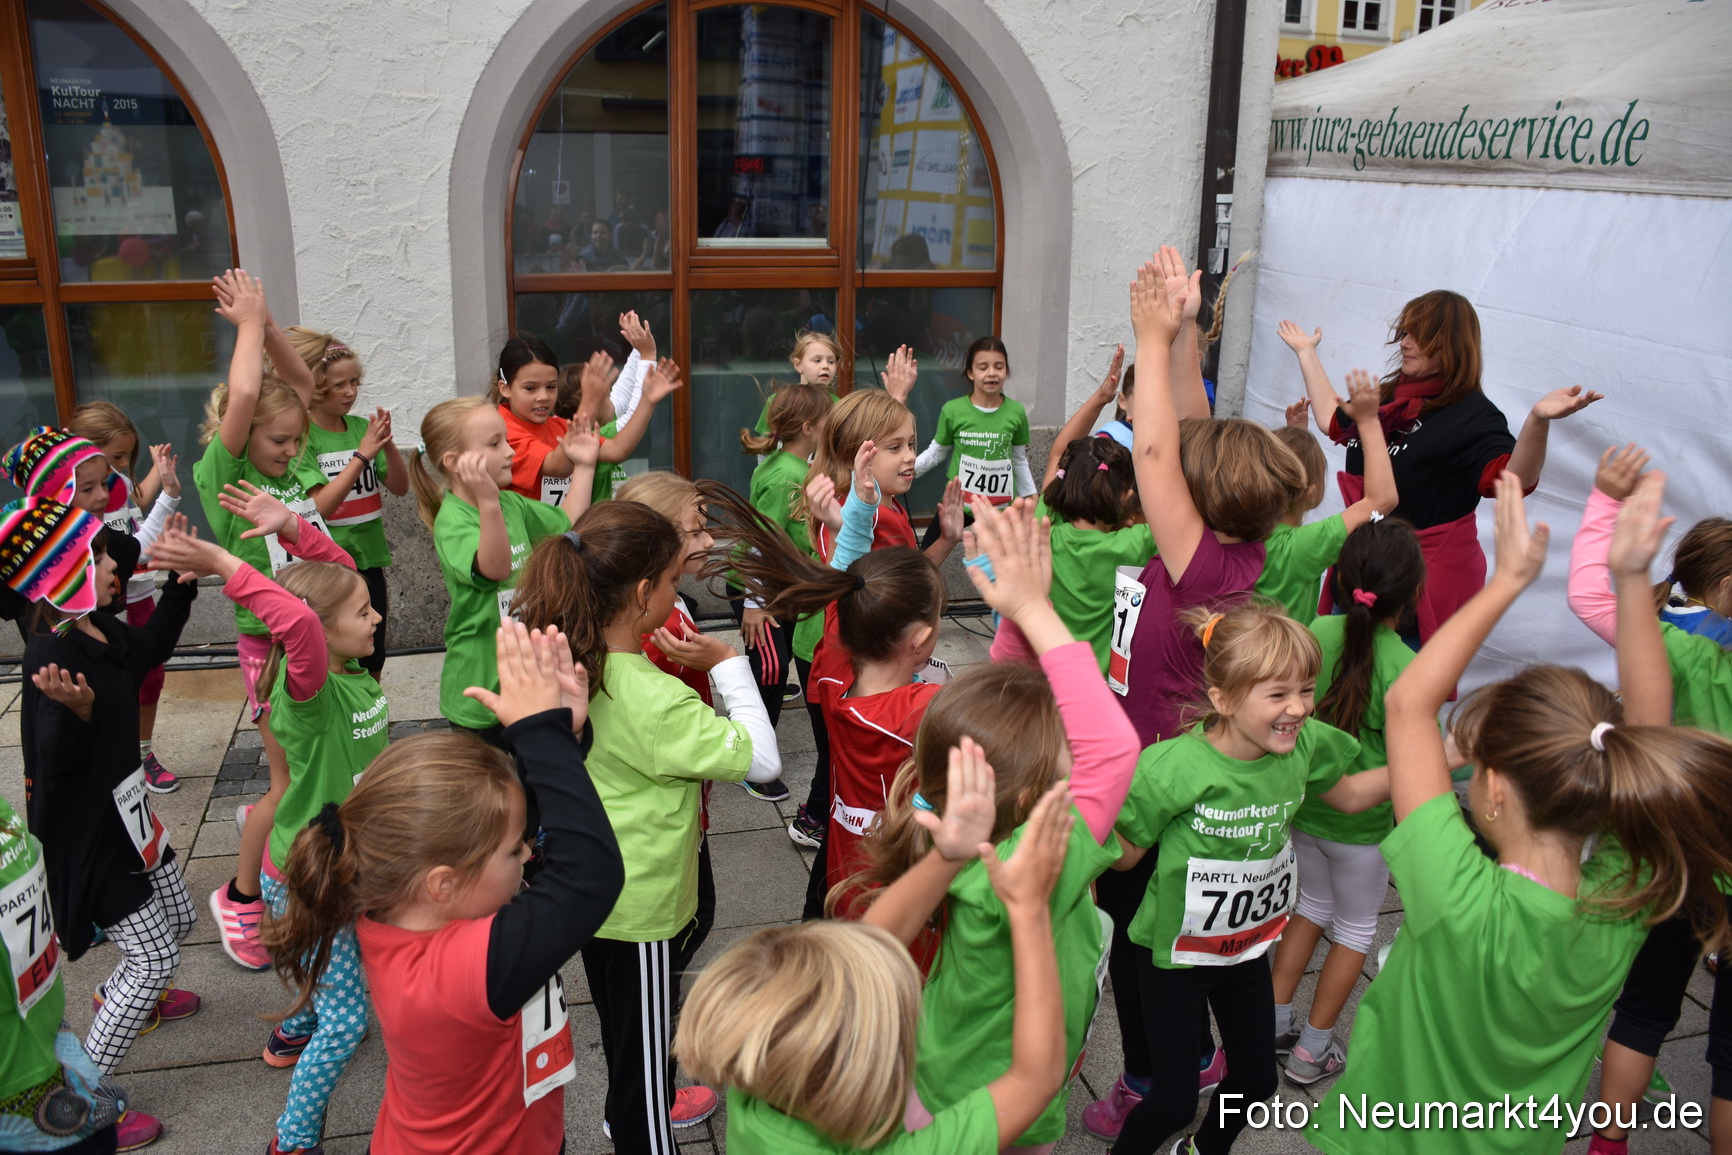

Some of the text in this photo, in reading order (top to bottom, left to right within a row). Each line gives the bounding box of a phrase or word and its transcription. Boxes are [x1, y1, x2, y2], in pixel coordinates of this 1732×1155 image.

[51, 85, 101, 97] KulTour
[53, 98, 138, 110] NACHT 2015
[1270, 98, 1650, 171] ww.jura-gebaeudeservice.de
[960, 431, 1000, 439] Neumarkter
[319, 459, 348, 469] PARTL
[961, 460, 979, 470] PARTL
[543, 478, 568, 486] PARTL
[964, 469, 1009, 494] 7407
[106, 518, 127, 528] ARTL
[117, 784, 141, 806] PARTL
[129, 793, 154, 841] 70
[1194, 803, 1279, 821] Neumarkter
[1190, 817, 1264, 839] Stadtlauf
[1191, 858, 1289, 884] PARTL Neumarkt
[0, 883, 39, 918] PARTL
[1201, 872, 1292, 932] 7033
[16, 888, 51, 958] 74
[1219, 932, 1262, 954] Marie
